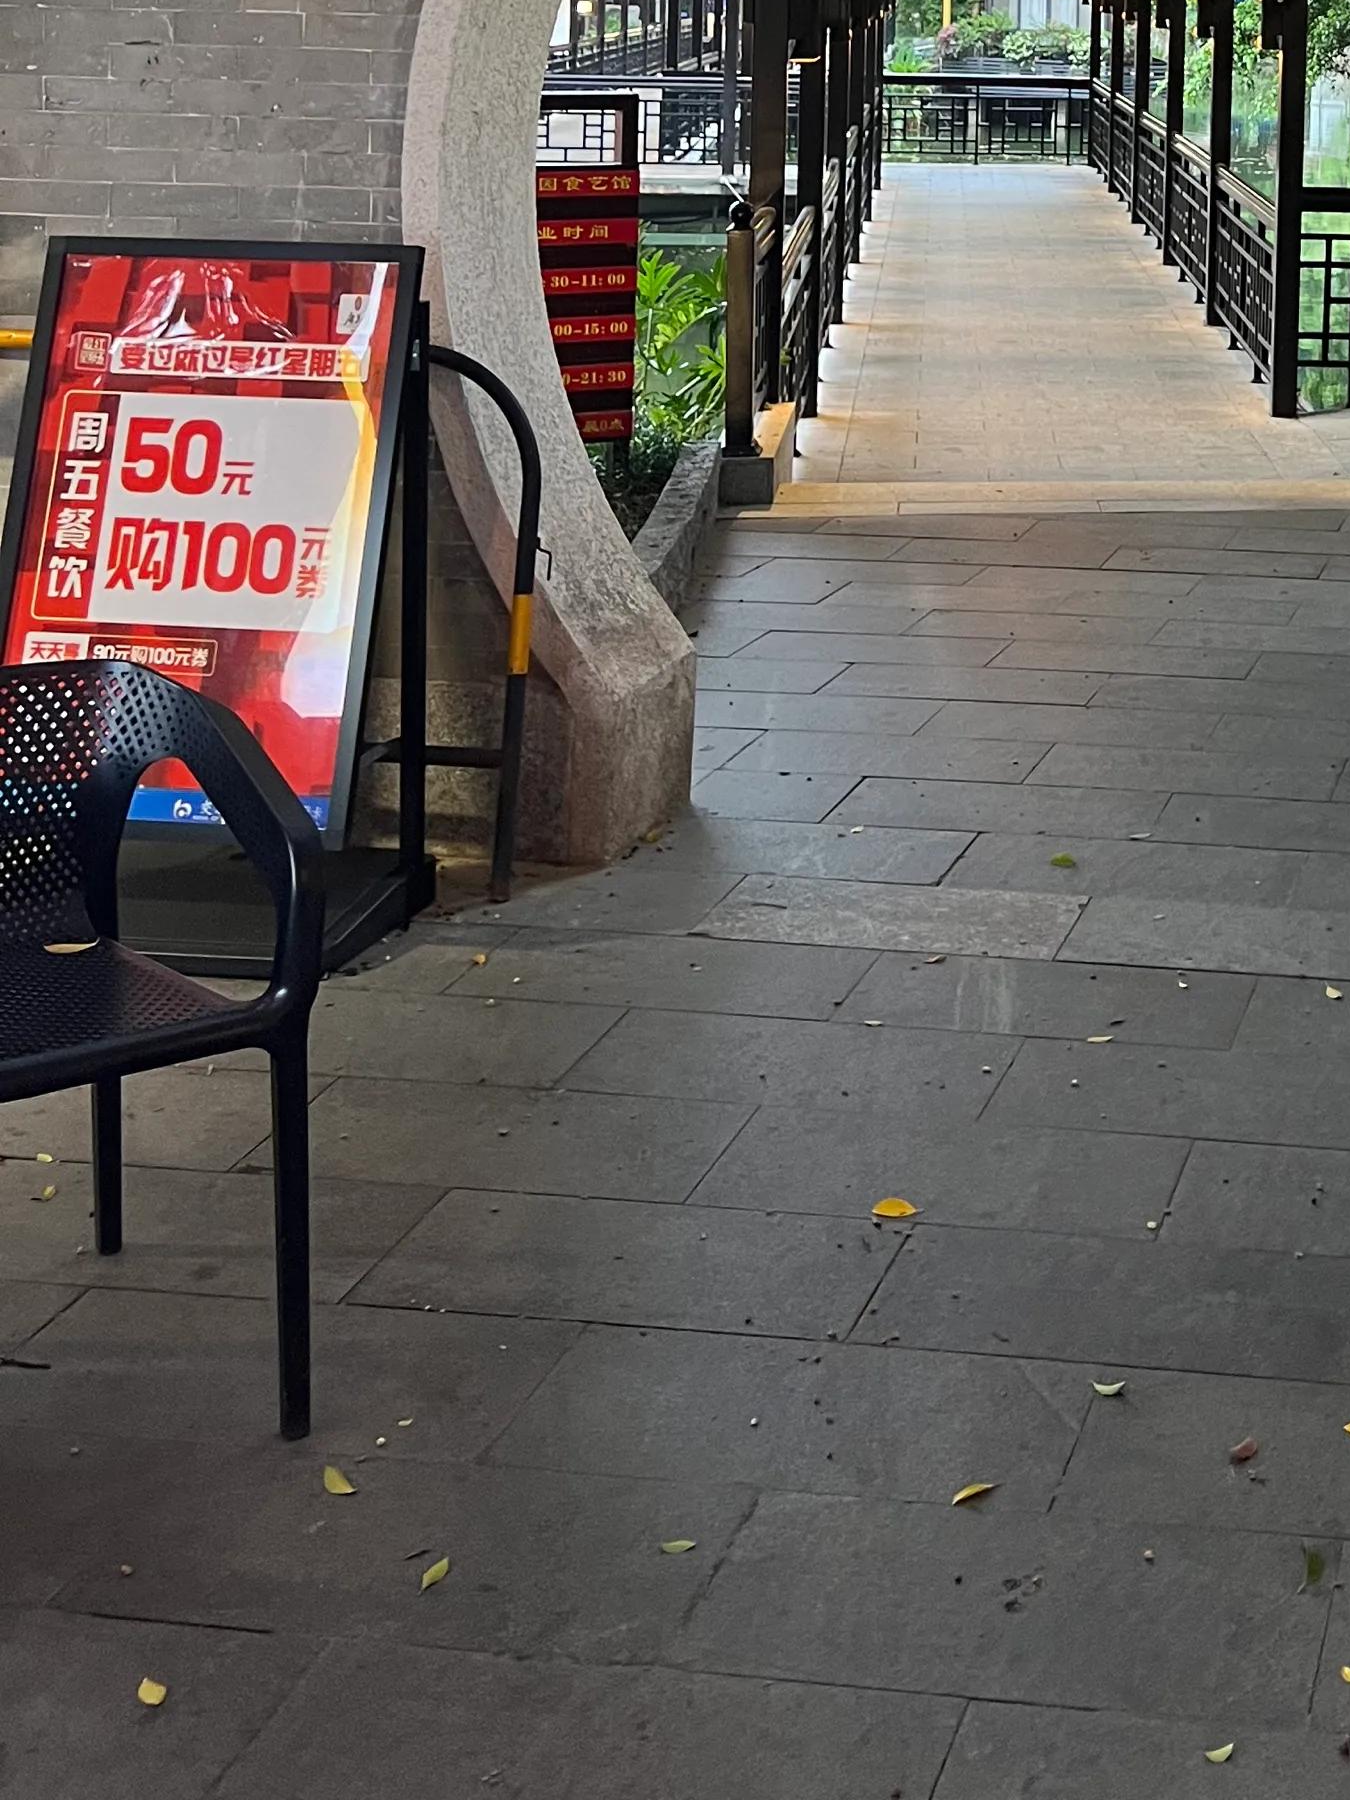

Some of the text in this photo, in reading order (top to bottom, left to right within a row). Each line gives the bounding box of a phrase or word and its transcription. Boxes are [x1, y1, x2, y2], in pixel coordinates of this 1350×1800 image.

[539, 175, 632, 192] 园食艺馆
[120, 416, 255, 496] 50元
[47, 411, 110, 599] 周五餐饮
